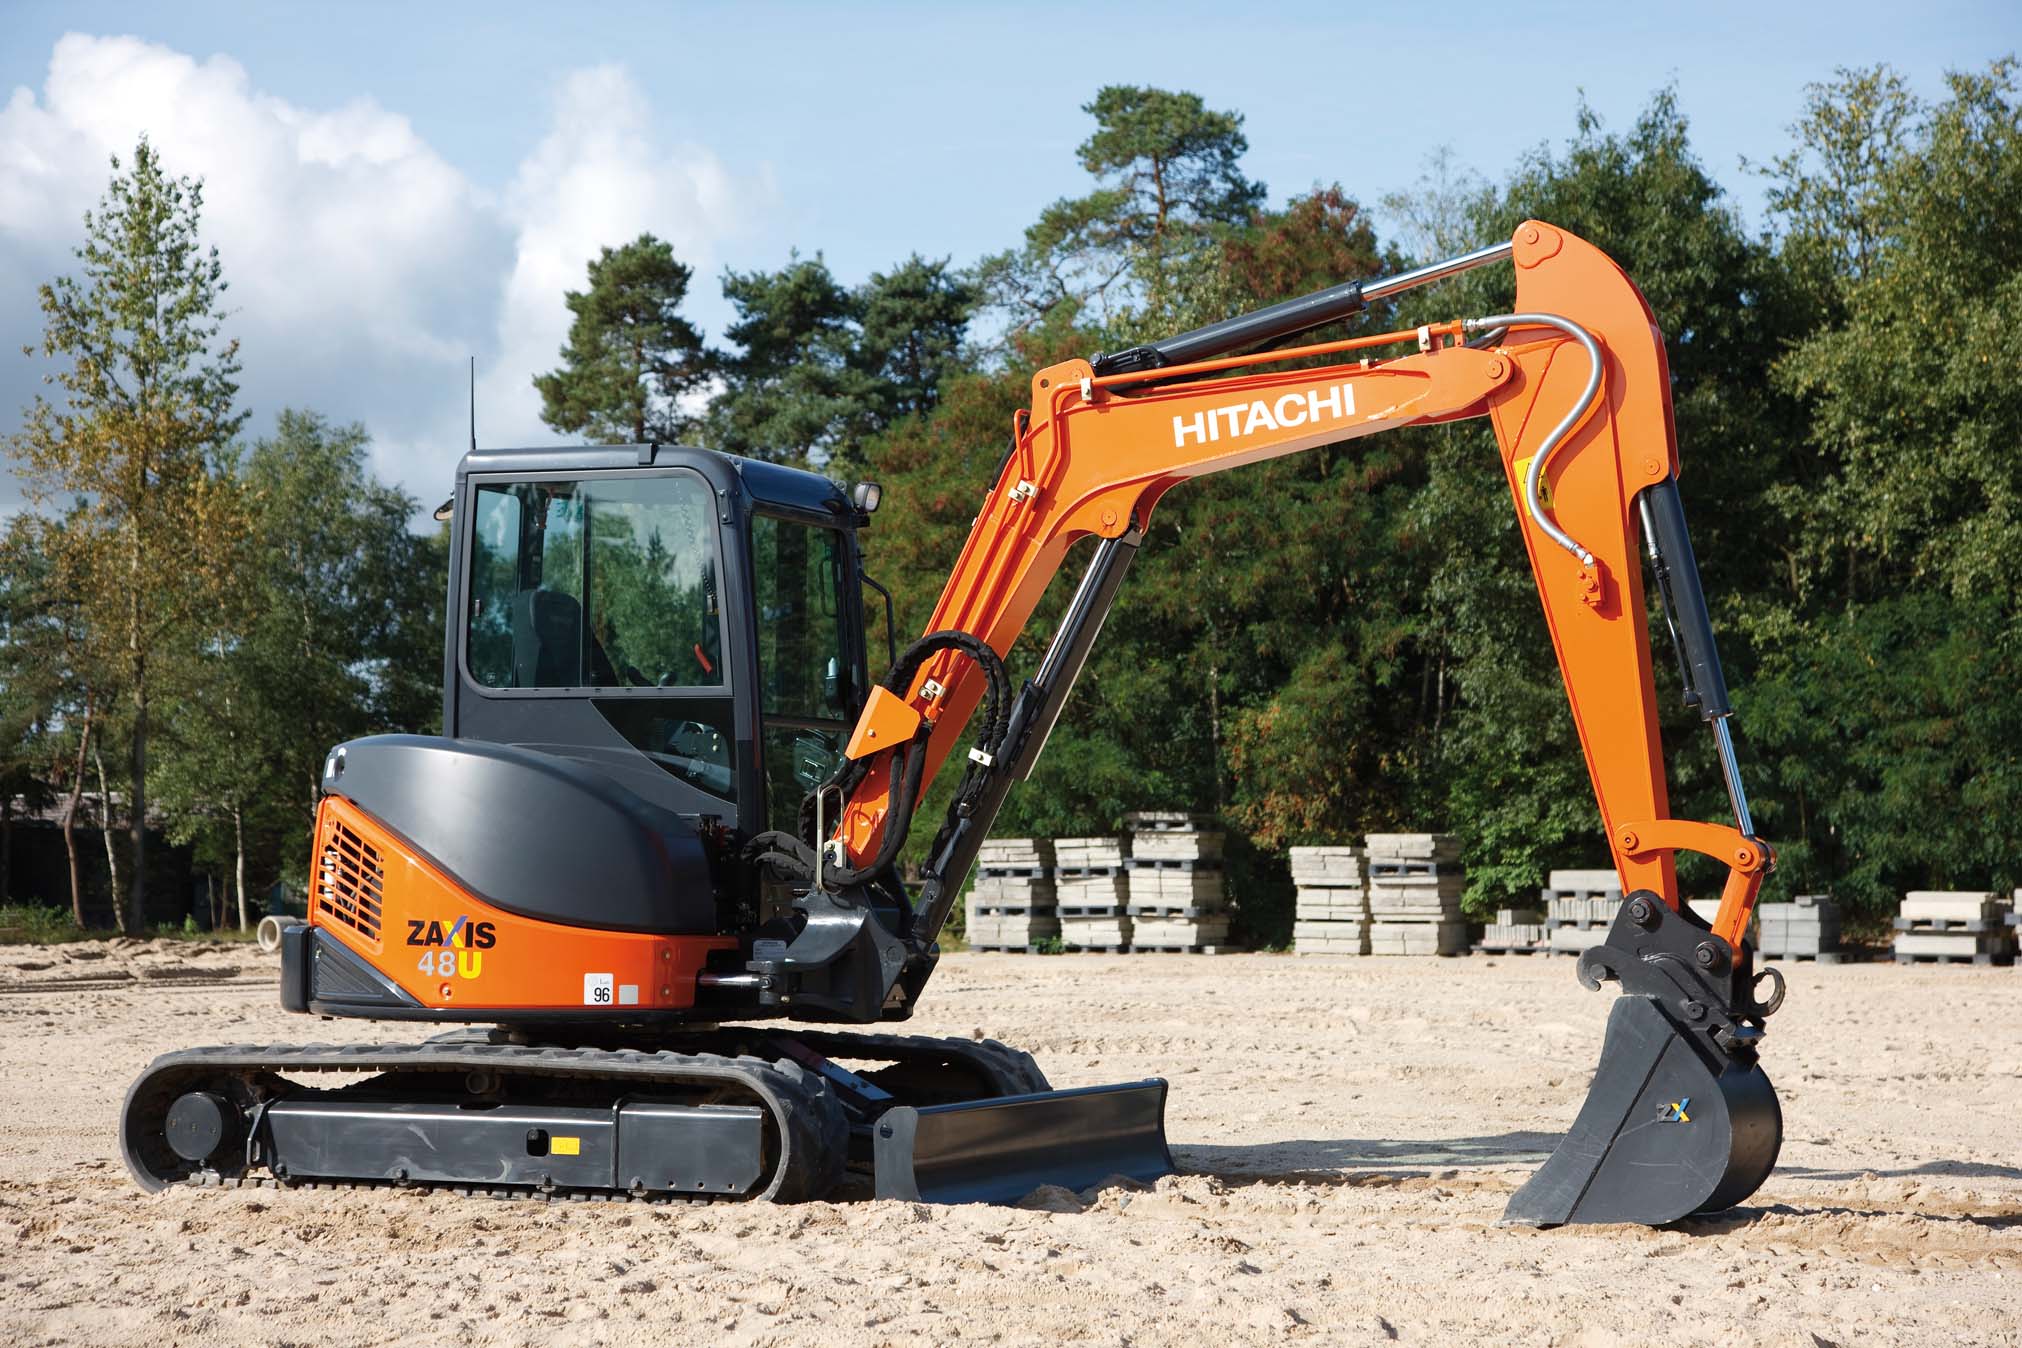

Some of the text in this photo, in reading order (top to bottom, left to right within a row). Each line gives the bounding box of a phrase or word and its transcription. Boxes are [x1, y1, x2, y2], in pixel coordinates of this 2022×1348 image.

[1172, 383, 1356, 448] HITACHI
[407, 915, 496, 949] ZAXIS
[417, 951, 482, 979] 48U
[594, 987, 610, 1003] 96
[1656, 1096, 1691, 1122] ZX
